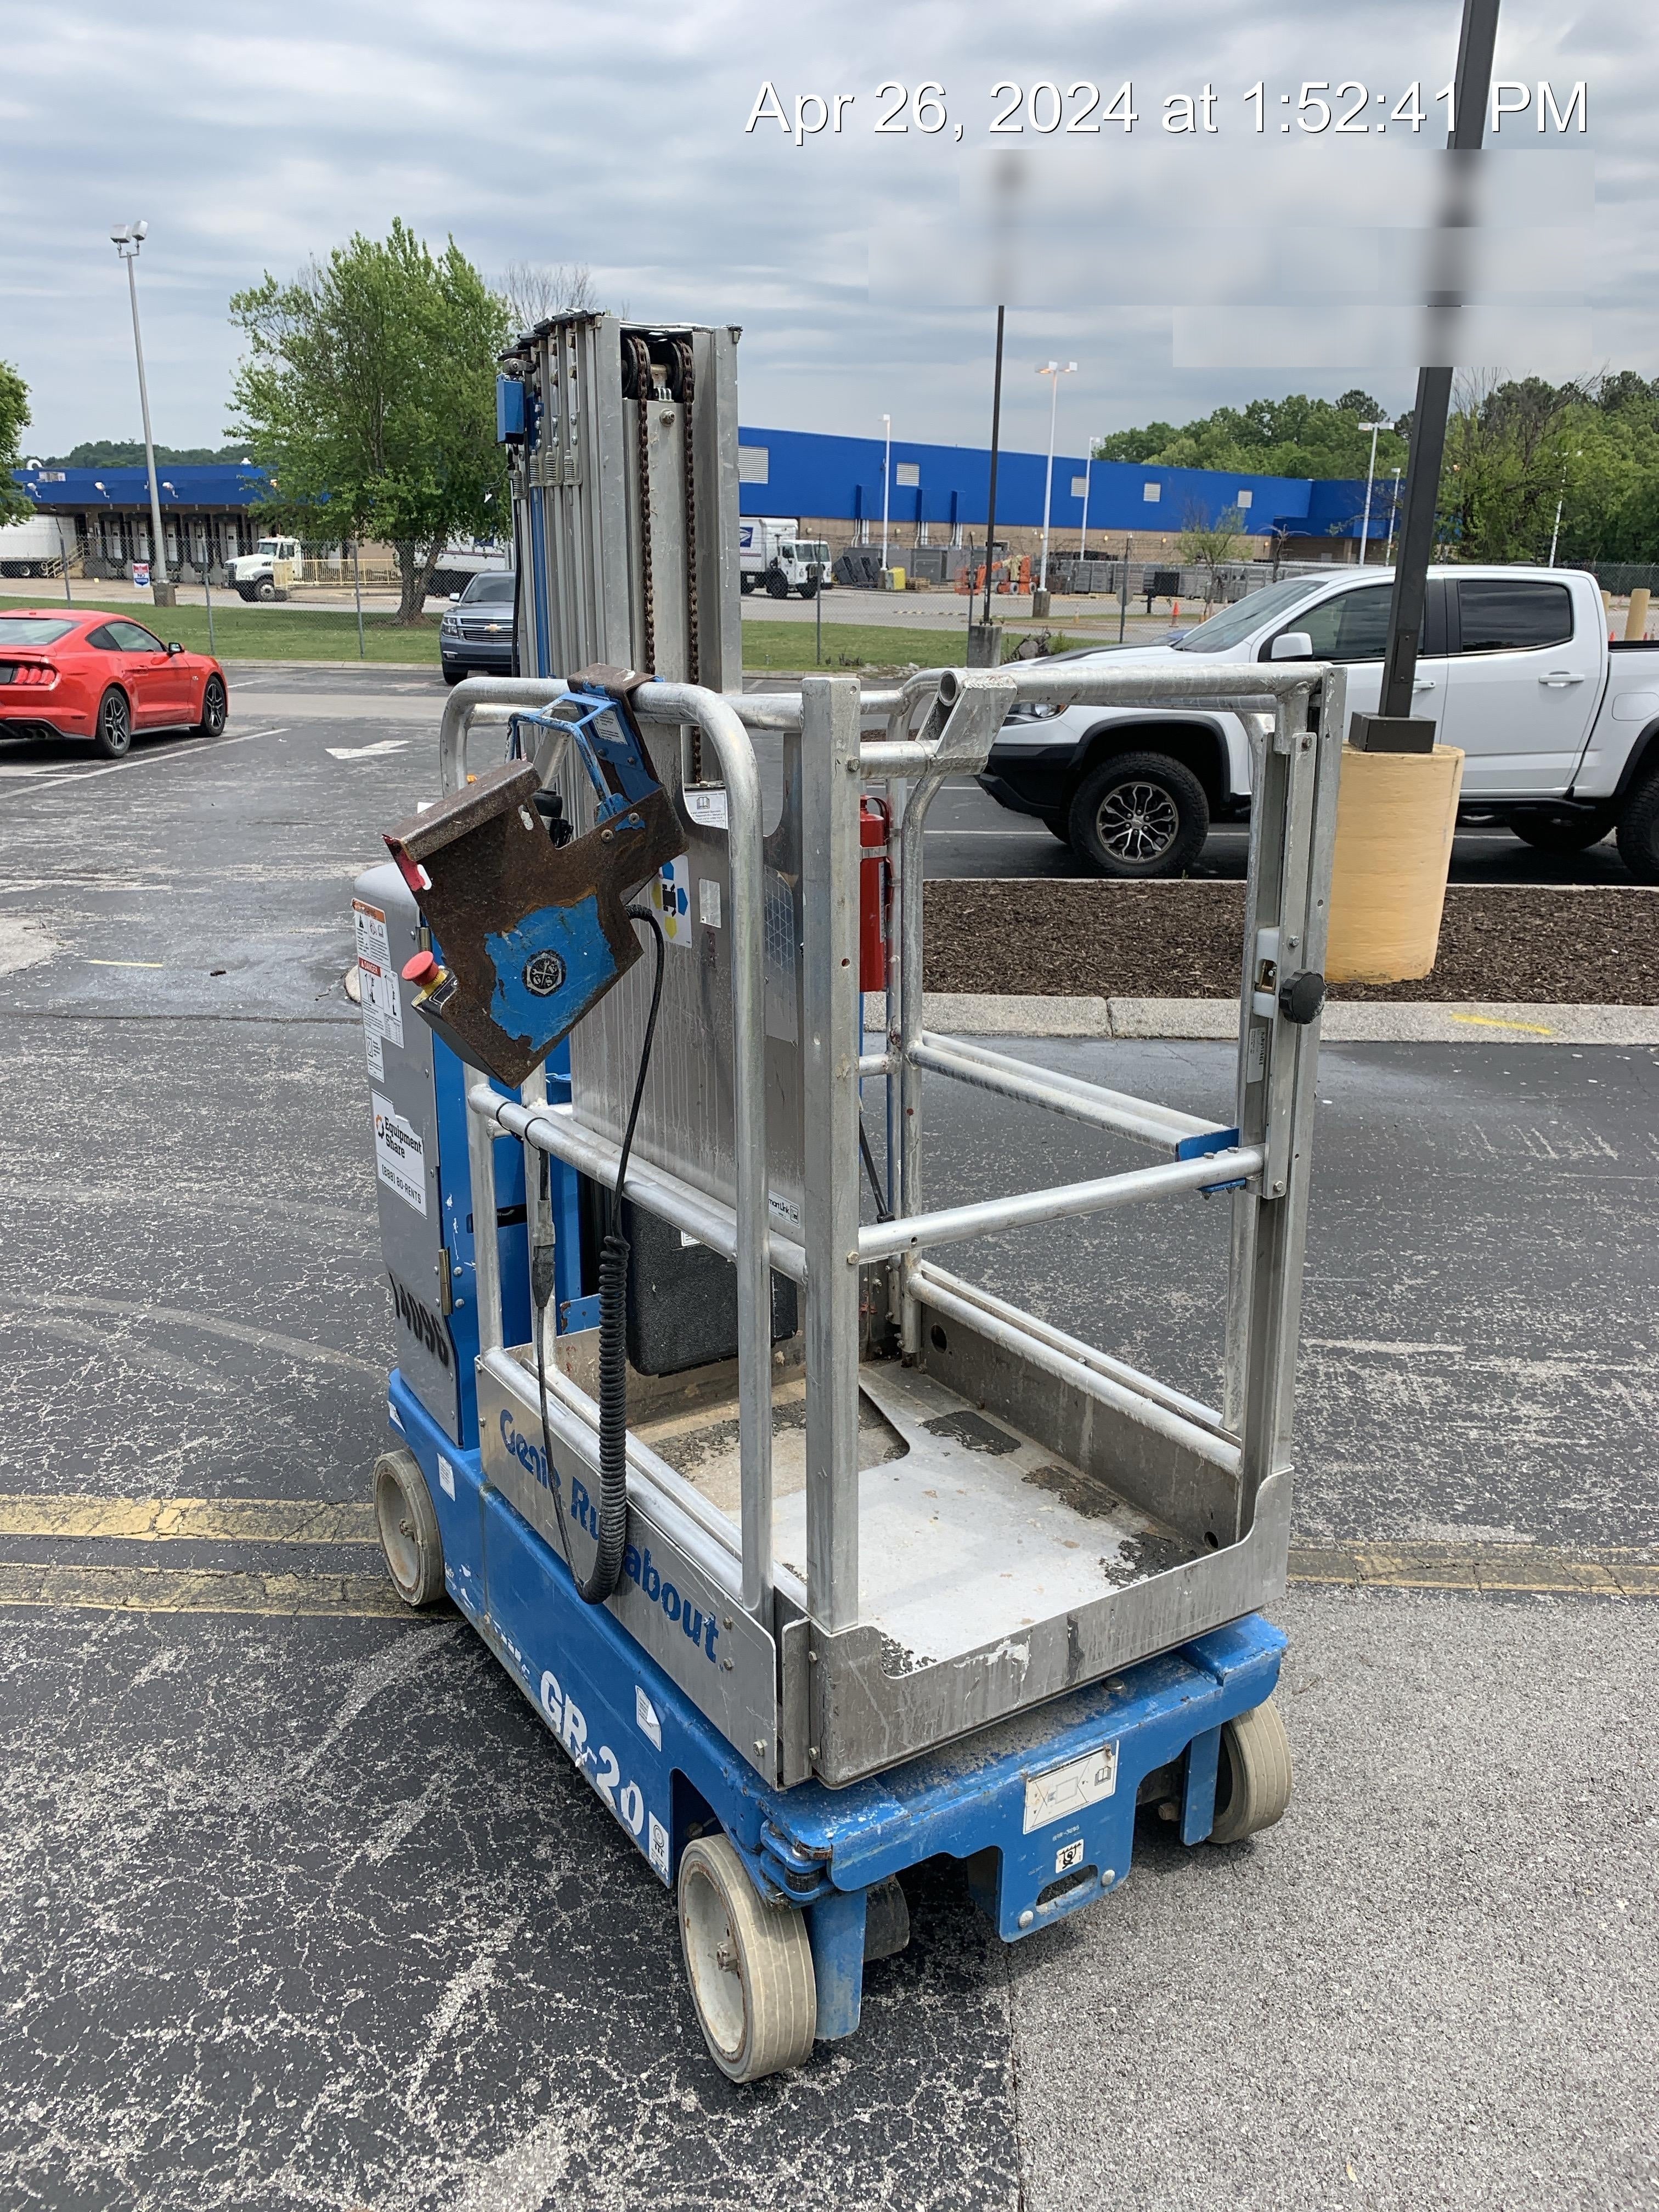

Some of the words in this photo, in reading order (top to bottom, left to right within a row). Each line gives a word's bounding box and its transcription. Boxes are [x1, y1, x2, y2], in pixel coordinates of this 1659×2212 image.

[385, 1116, 422, 1155] Equipment
[386, 1133, 406, 1159] Share
[382, 1164, 396, 1184] (888)
[396, 1176, 422, 1205] 80-RENTS
[540, 1670, 645, 1836] GR-20
